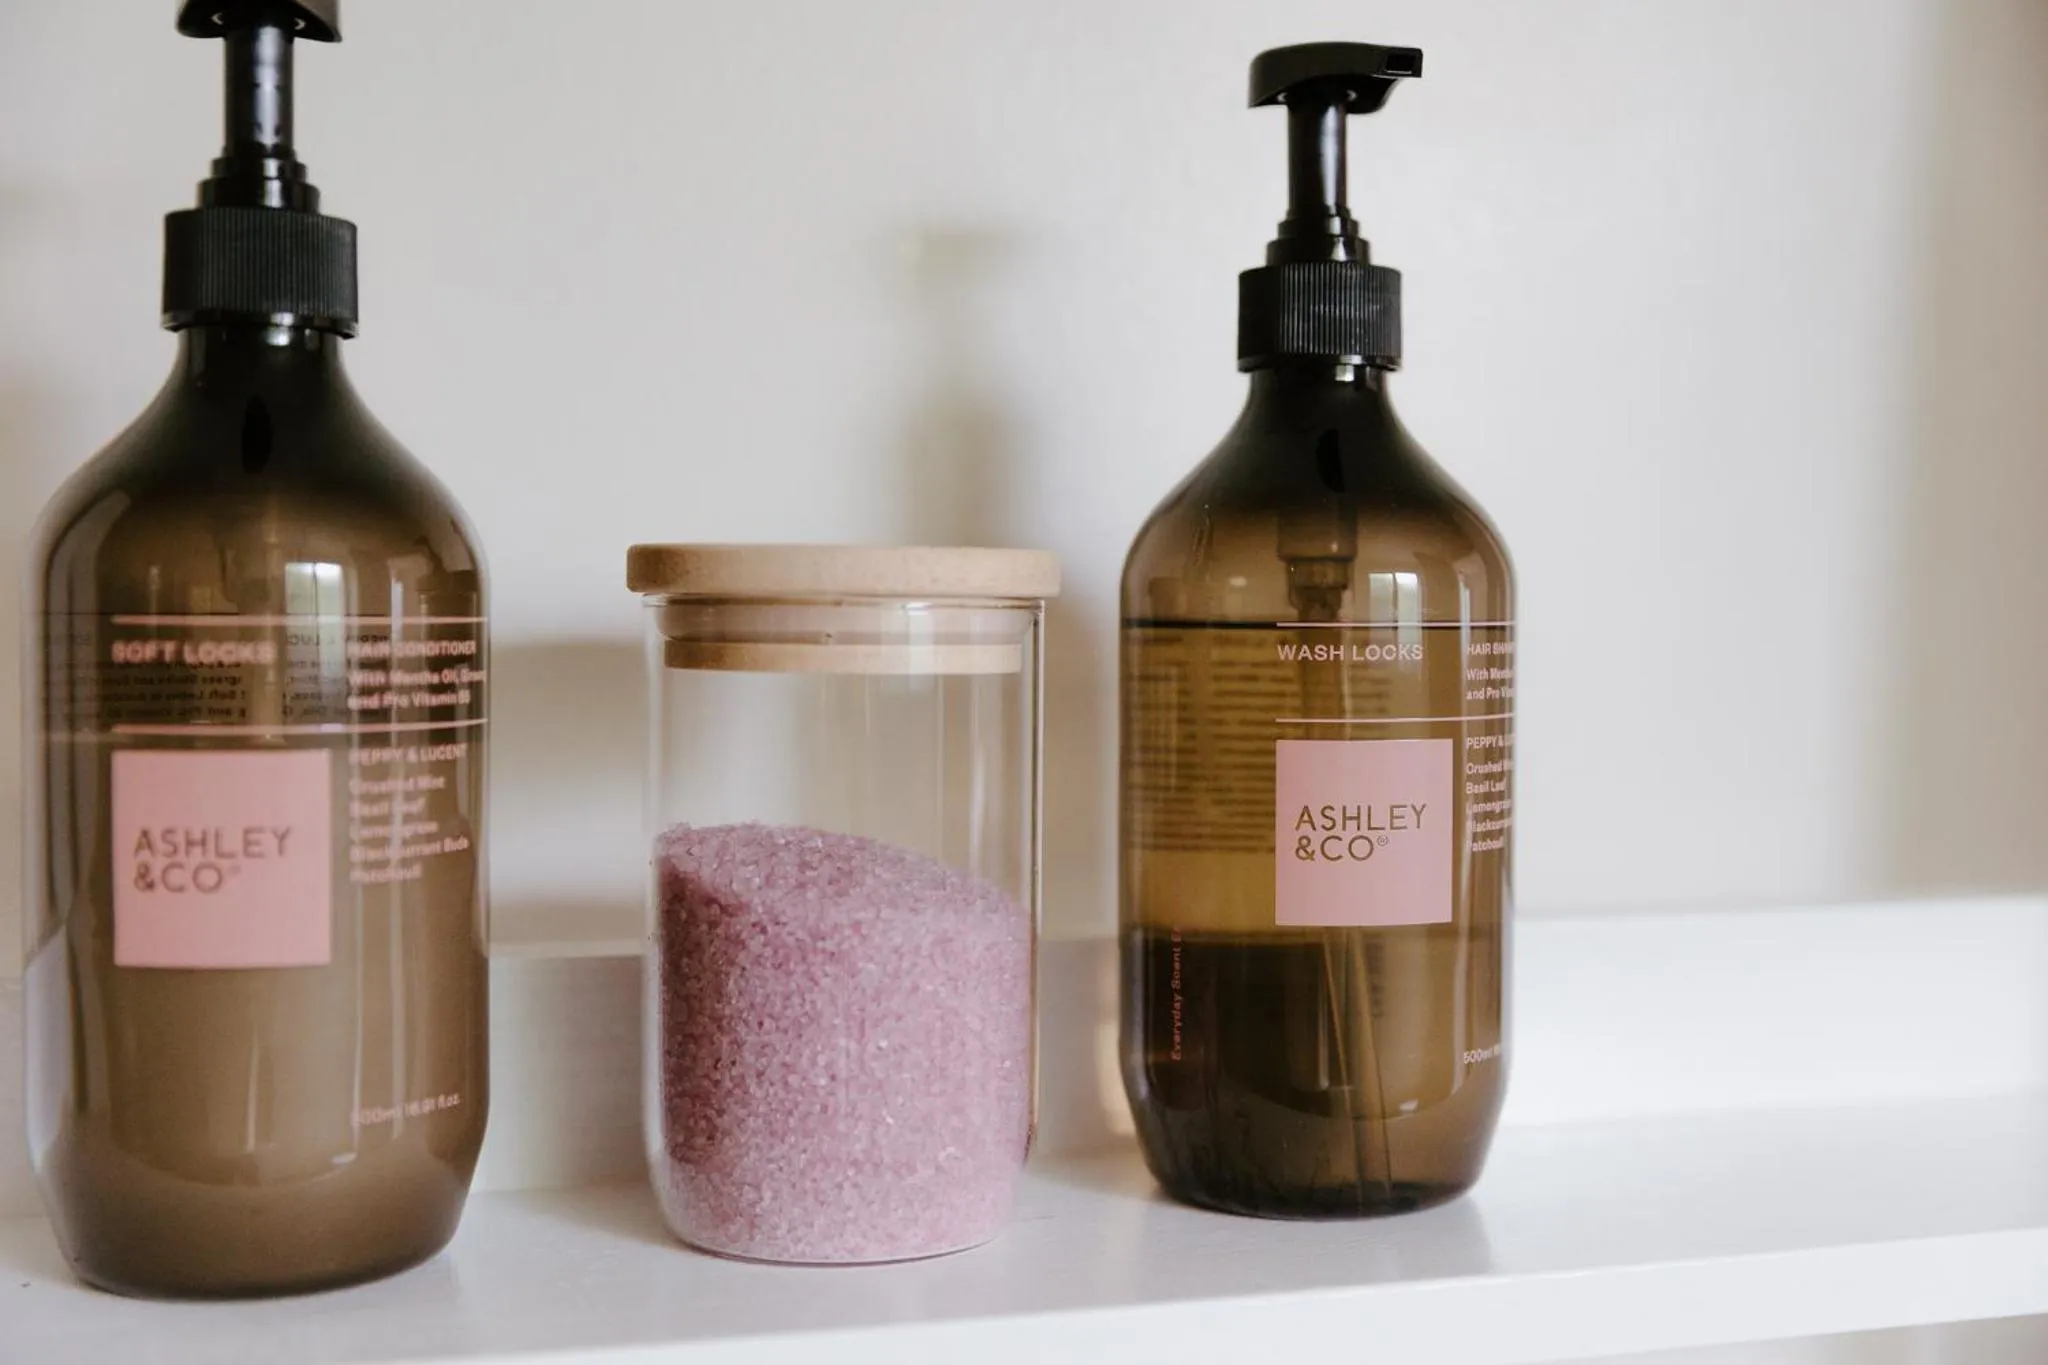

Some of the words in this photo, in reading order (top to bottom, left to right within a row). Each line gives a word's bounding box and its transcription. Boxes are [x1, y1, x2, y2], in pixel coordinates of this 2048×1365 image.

[111, 641, 176, 663] SOFT
[183, 641, 277, 664] LOCKS
[1277, 644, 1344, 661] WASH
[1352, 644, 1423, 662] LOCKS
[1467, 642, 1491, 656] HAIR
[1466, 687, 1484, 700] and
[1466, 736, 1497, 749] PEPPY
[1295, 804, 1427, 831] ASHLEY
[134, 826, 292, 860] ASHLEY
[1170, 948, 1182, 990] Scent
[1170, 994, 1184, 1061] Everyday
